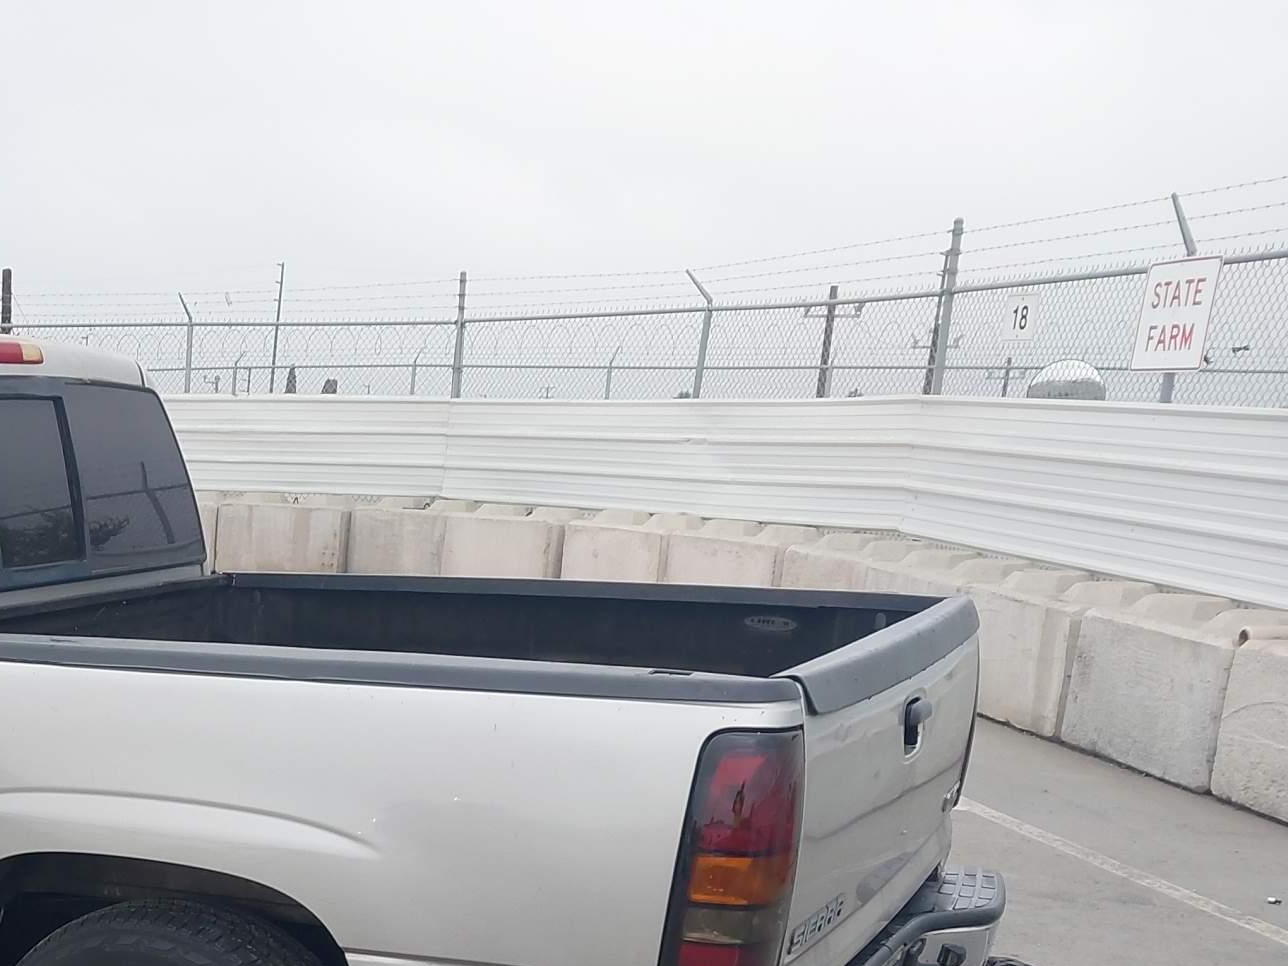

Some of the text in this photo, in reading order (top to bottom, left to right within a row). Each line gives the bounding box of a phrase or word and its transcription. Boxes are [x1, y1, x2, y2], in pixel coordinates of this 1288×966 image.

[1152, 277, 1207, 309] STATE
[1013, 304, 1029, 330] 18
[1145, 323, 1195, 352] FARM
